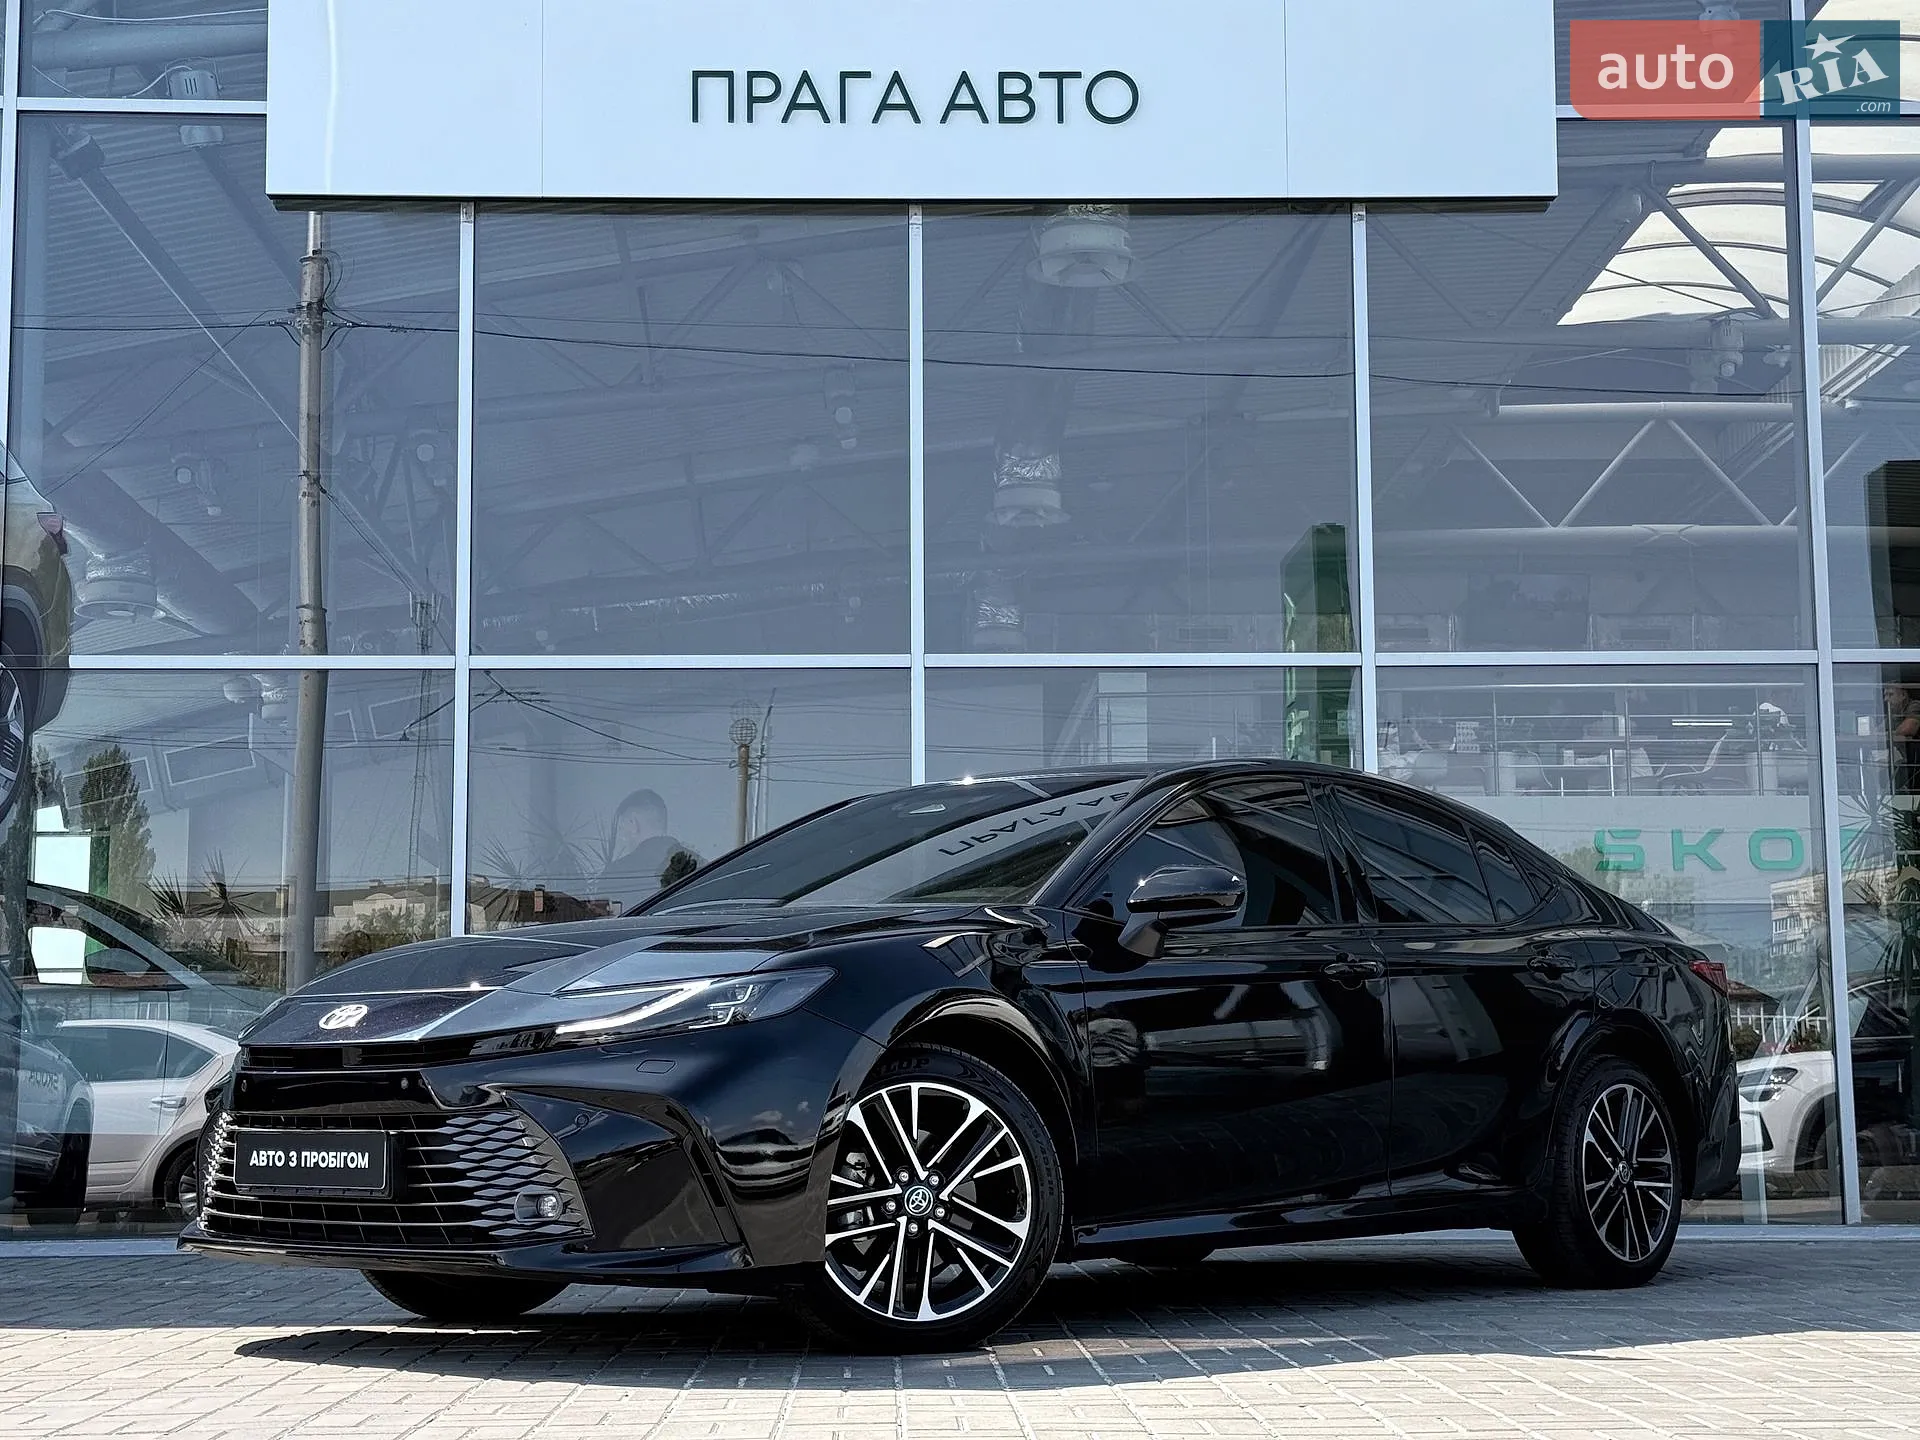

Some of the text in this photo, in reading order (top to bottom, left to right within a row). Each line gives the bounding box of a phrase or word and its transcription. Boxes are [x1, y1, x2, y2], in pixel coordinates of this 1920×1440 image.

[692, 70, 1140, 124] ПРАГА АВТО
[1594, 828, 1860, 872] SKO
[249, 1150, 286, 1168] АВТО
[301, 1151, 369, 1169] ПРОБІГОМ
